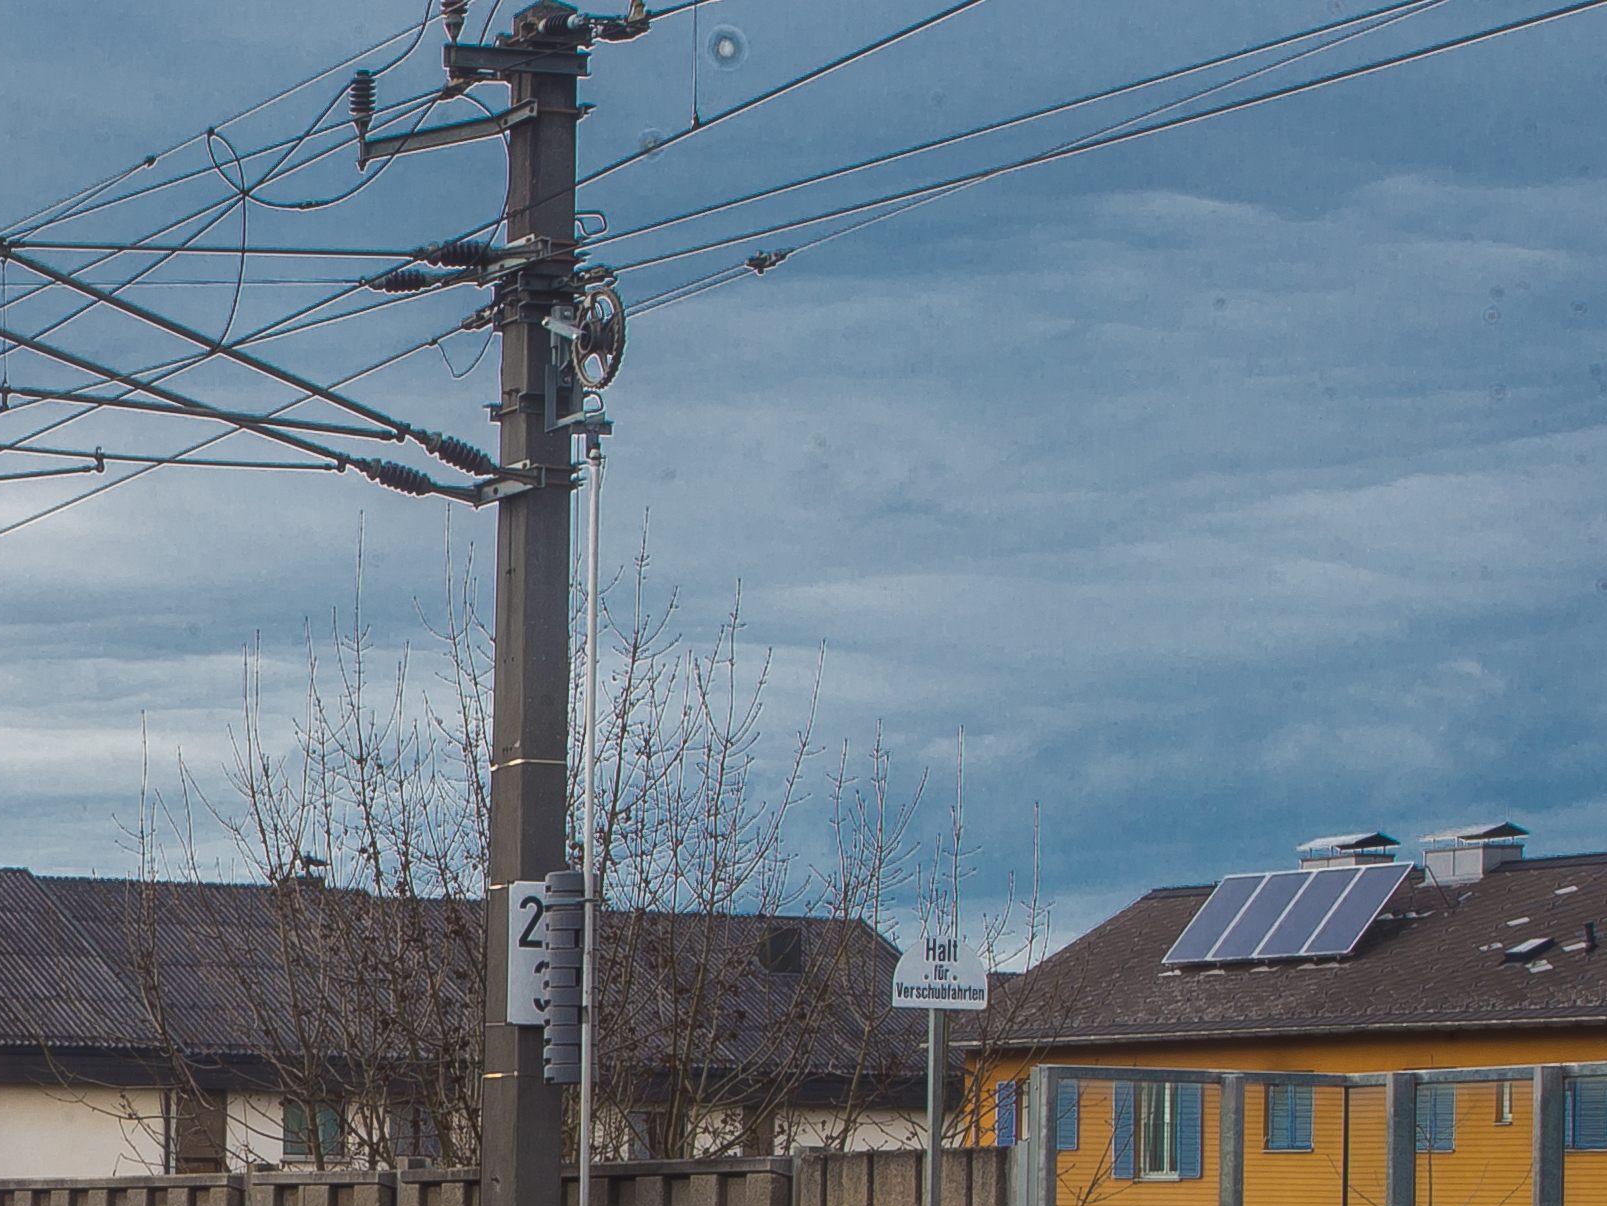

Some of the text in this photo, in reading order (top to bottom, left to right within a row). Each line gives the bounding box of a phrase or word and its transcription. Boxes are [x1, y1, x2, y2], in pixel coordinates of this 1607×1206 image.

[925, 938, 958, 962] Halt
[933, 964, 950, 981] für
[896, 982, 985, 1001] Verschubfahrten
